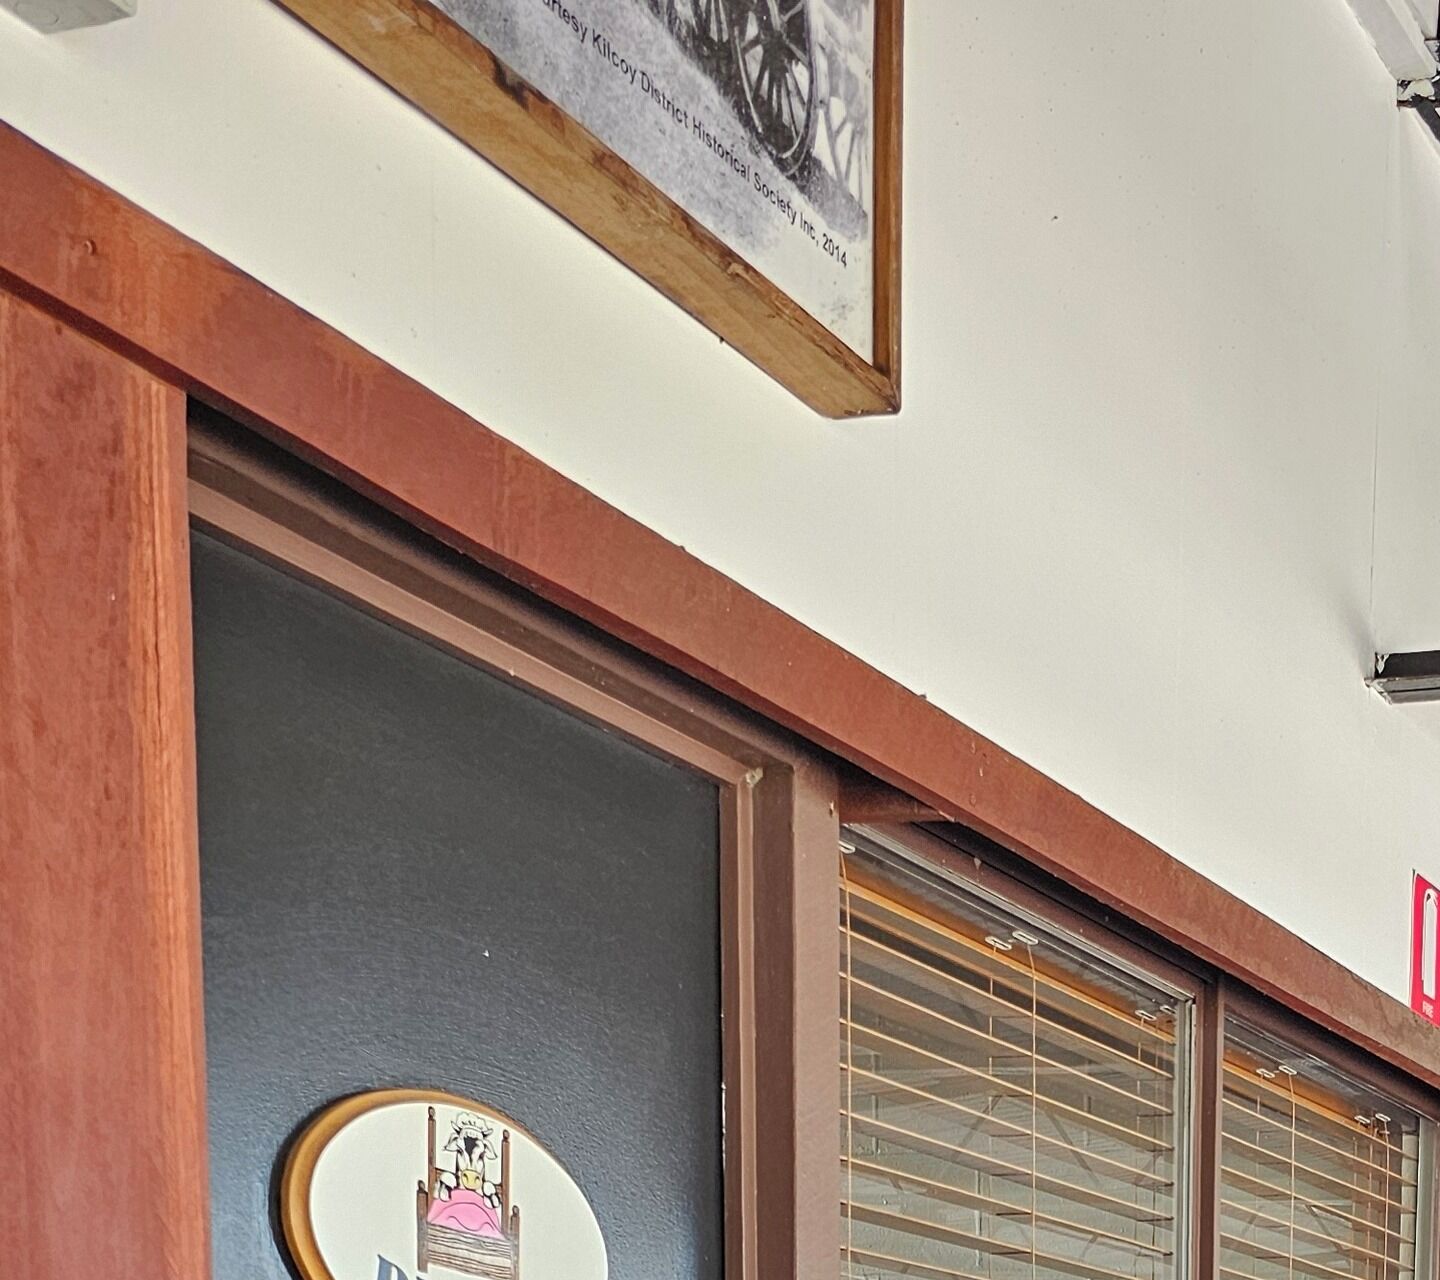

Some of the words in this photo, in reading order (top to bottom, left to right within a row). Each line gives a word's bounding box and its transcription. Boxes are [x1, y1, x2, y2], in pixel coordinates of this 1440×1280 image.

[592, 29, 637, 85] Kilcoy
[639, 70, 688, 128] District
[693, 116, 750, 182] Historical
[753, 172, 797, 225] Society
[822, 233, 847, 268] 2014
